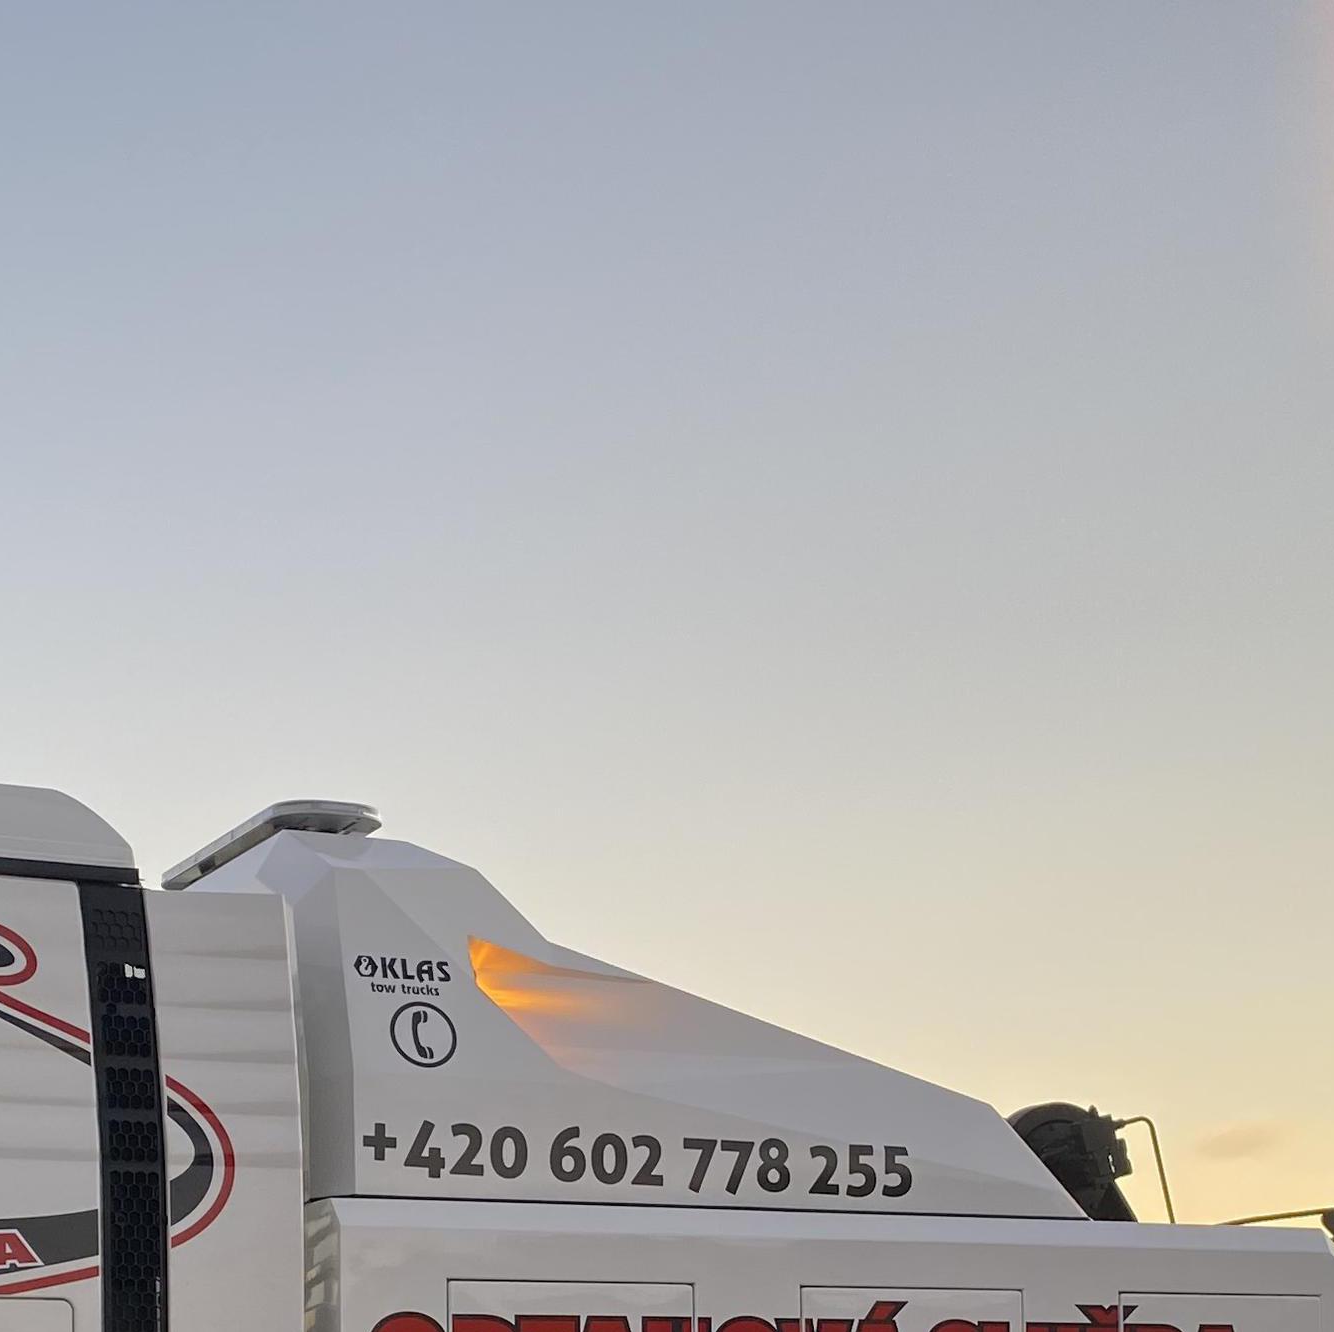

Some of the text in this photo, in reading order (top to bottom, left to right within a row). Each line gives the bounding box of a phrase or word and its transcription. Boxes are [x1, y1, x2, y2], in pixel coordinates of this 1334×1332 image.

[380, 956, 451, 983] KLAS
[370, 981, 440, 996] tow trucks
[362, 1119, 913, 1198] +420 602 778 255
